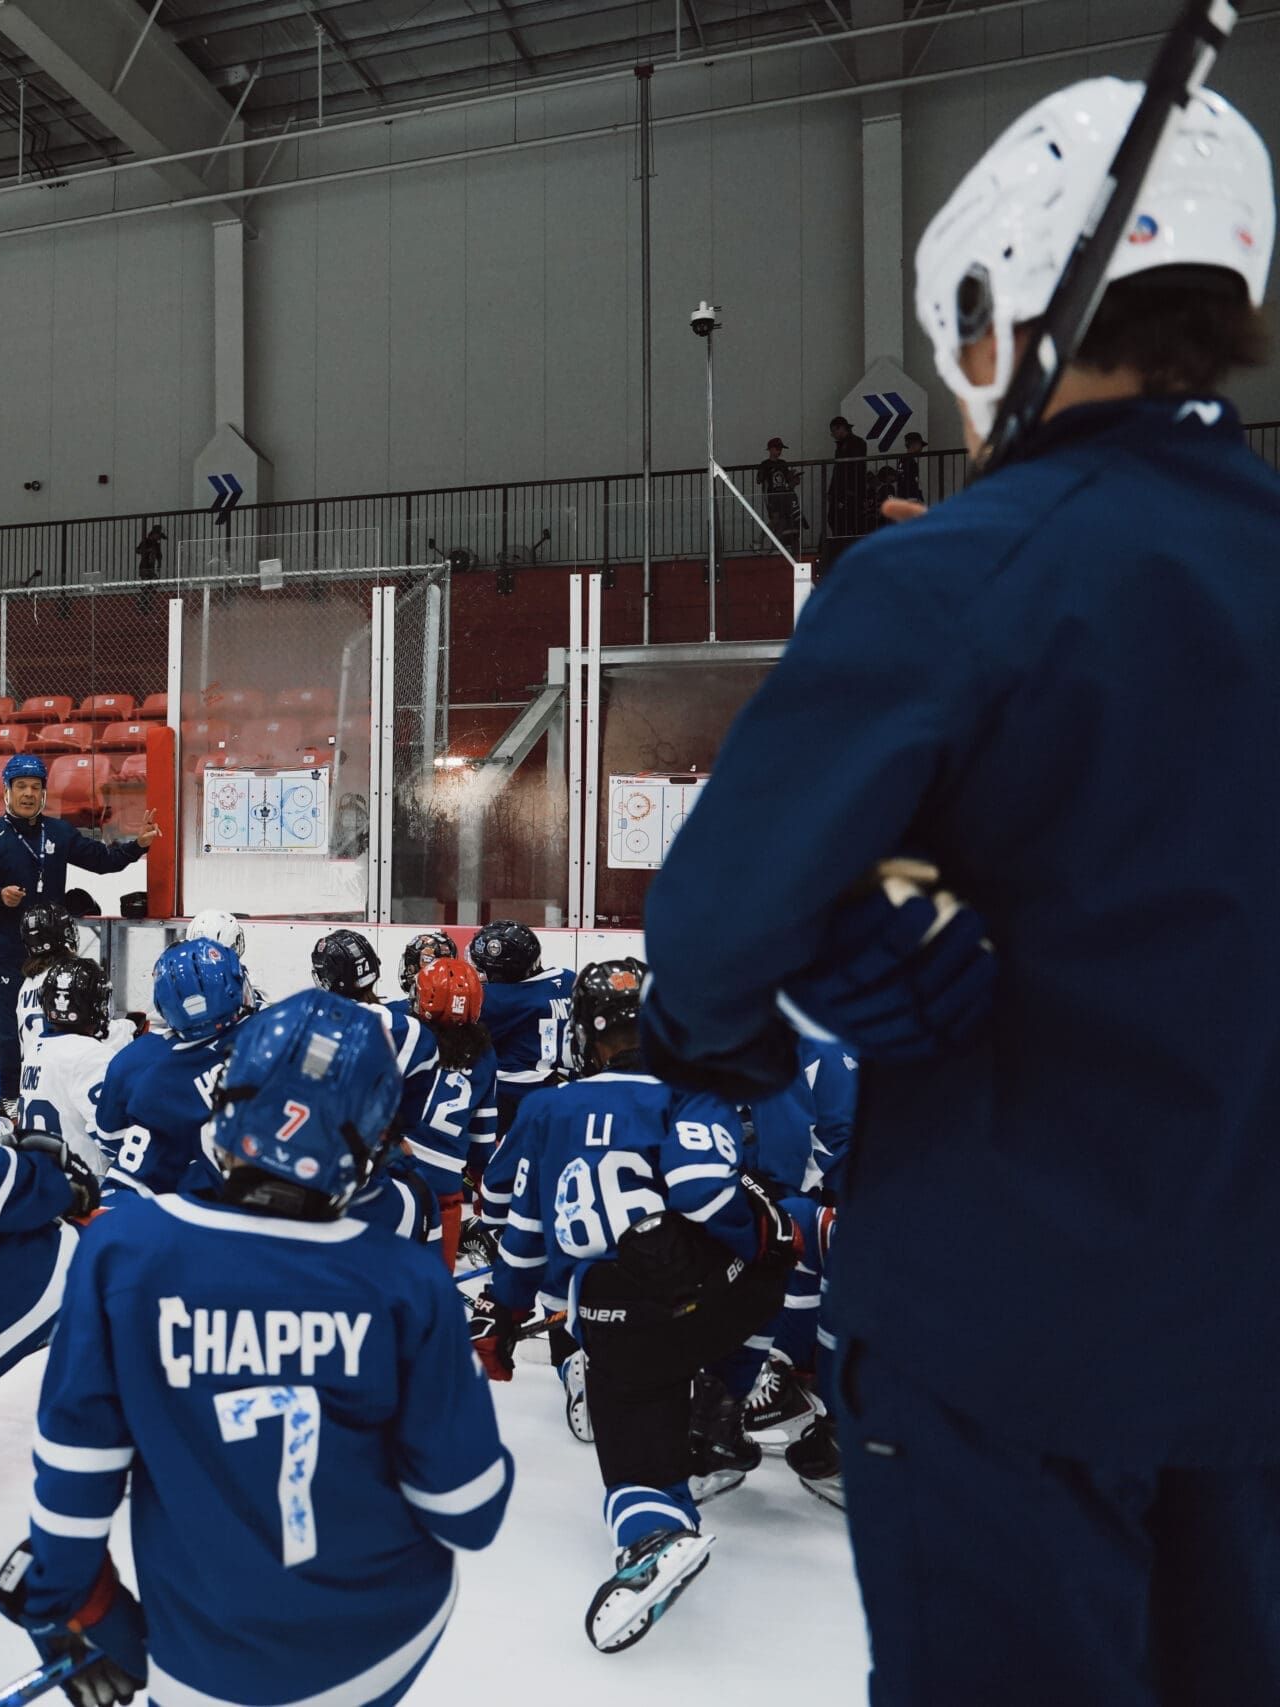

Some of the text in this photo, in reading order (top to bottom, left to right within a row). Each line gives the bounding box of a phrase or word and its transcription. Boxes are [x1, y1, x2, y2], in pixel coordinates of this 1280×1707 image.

[356, 961, 370, 976] 84
[275, 1099, 311, 1143] 7
[585, 1113, 613, 1147] LI
[675, 1120, 737, 1164] 86
[118, 1124, 152, 1174] 8
[513, 1157, 531, 1198] 6
[554, 1150, 666, 1259] 86
[578, 1305, 627, 1323] AUER
[158, 1296, 372, 1388] CHAPPY
[213, 1384, 321, 1569] 7
